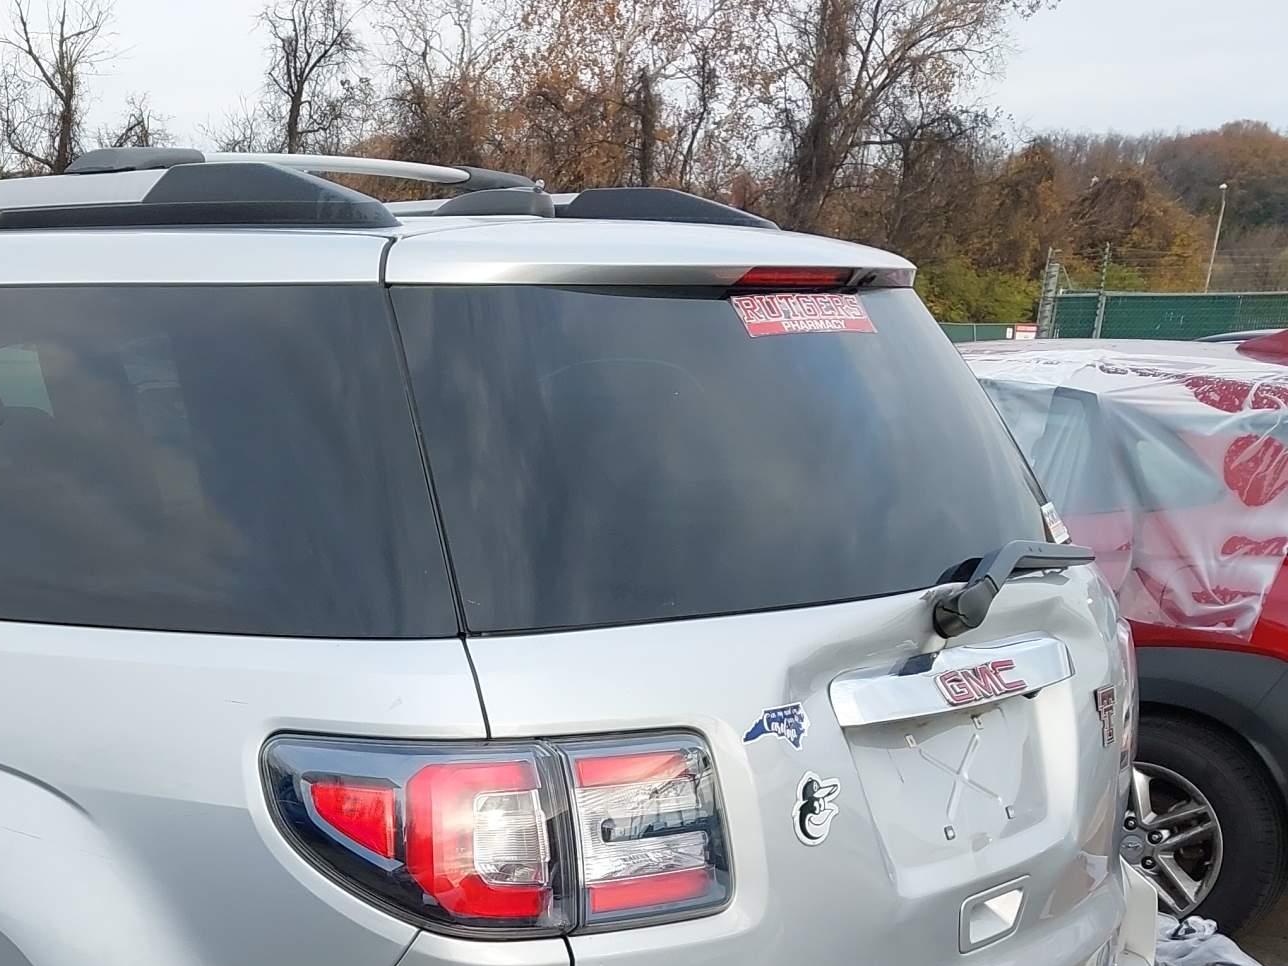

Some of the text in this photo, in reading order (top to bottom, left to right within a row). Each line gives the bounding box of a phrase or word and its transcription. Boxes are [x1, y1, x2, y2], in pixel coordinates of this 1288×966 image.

[734, 294, 865, 322] RUTGERS
[783, 319, 847, 332] PHARMACY
[934, 659, 1028, 706] GMC
